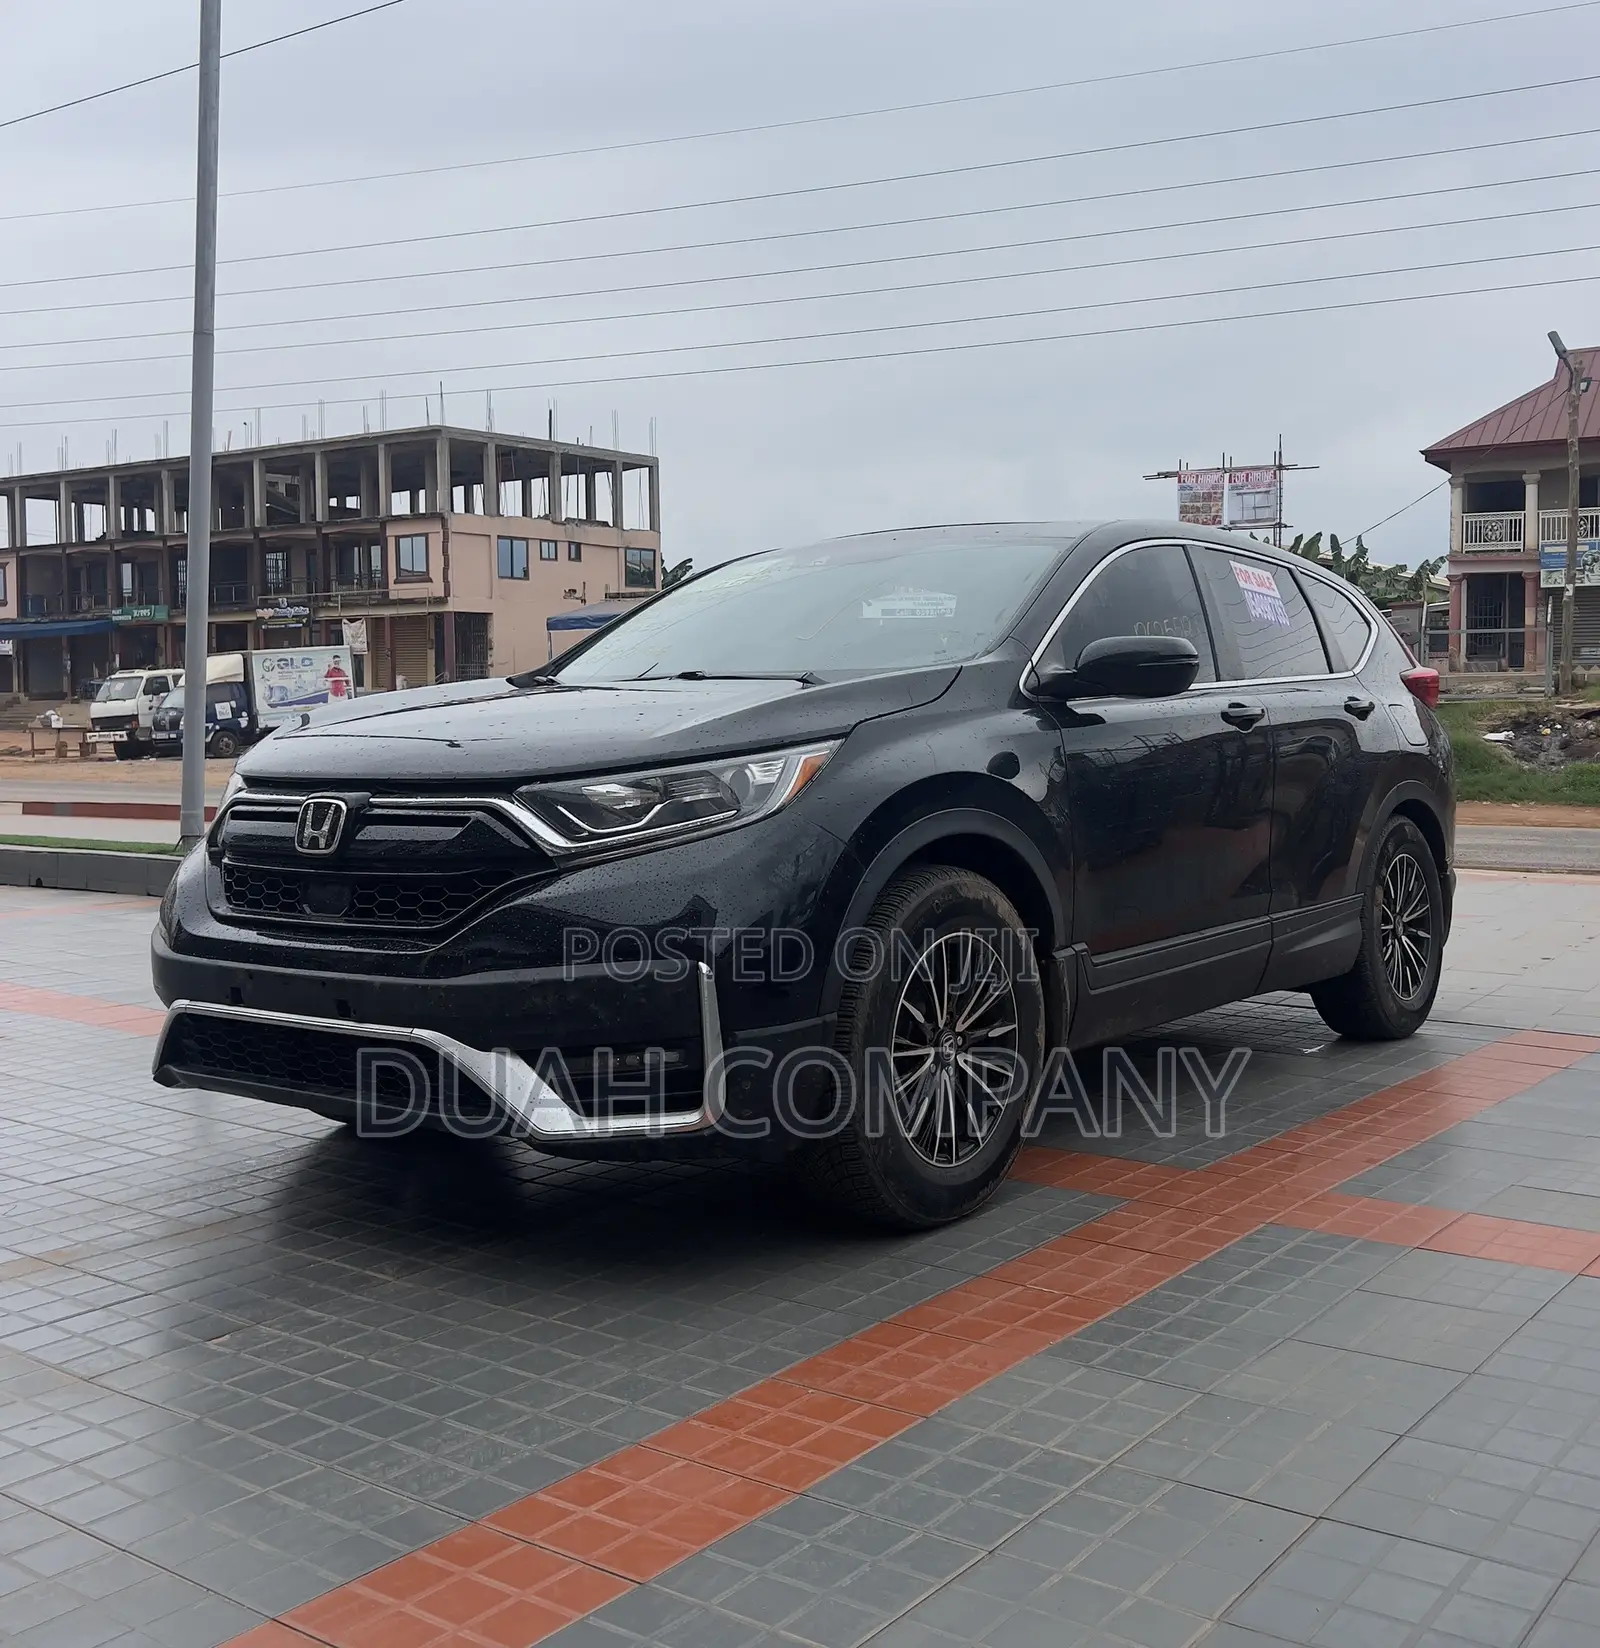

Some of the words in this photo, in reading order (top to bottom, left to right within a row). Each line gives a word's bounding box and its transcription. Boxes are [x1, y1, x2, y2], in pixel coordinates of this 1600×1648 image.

[1181, 473, 1196, 484] FOR
[1198, 472, 1224, 484] HIRING
[1232, 473, 1247, 483] FOR
[1248, 470, 1274, 483] HIRING
[1233, 566, 1254, 585] FOR
[1251, 571, 1276, 592] SALE
